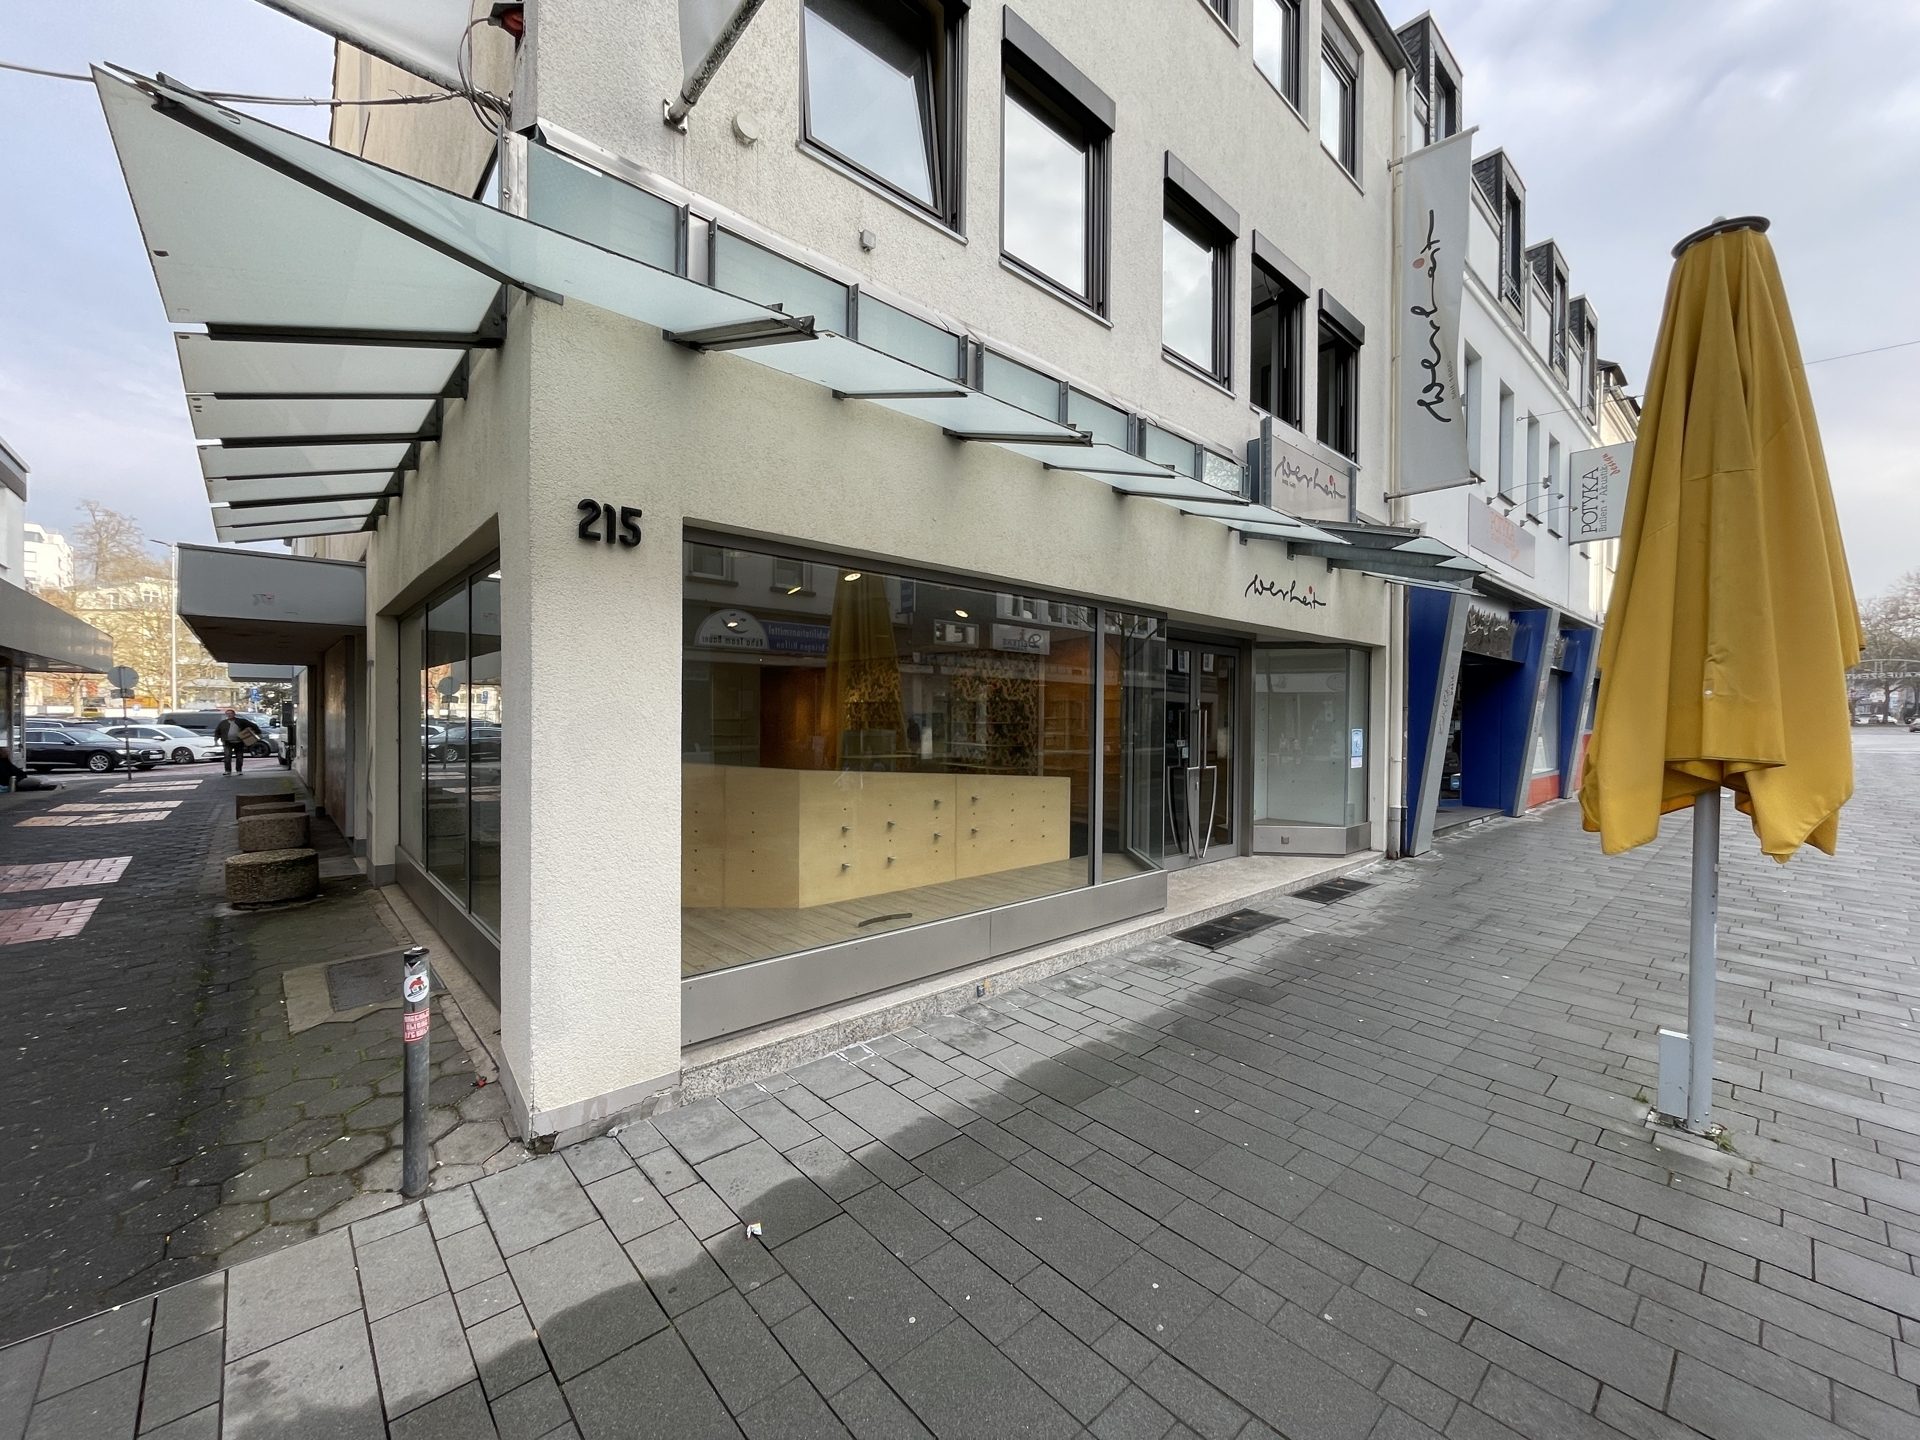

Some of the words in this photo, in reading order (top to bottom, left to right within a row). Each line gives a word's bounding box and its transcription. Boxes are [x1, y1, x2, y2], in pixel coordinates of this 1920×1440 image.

[1581, 467, 1599, 534] POTYKA
[1599, 465, 1608, 496] Akustik
[577, 498, 643, 547] 215
[1599, 505, 1607, 532] Brillen
